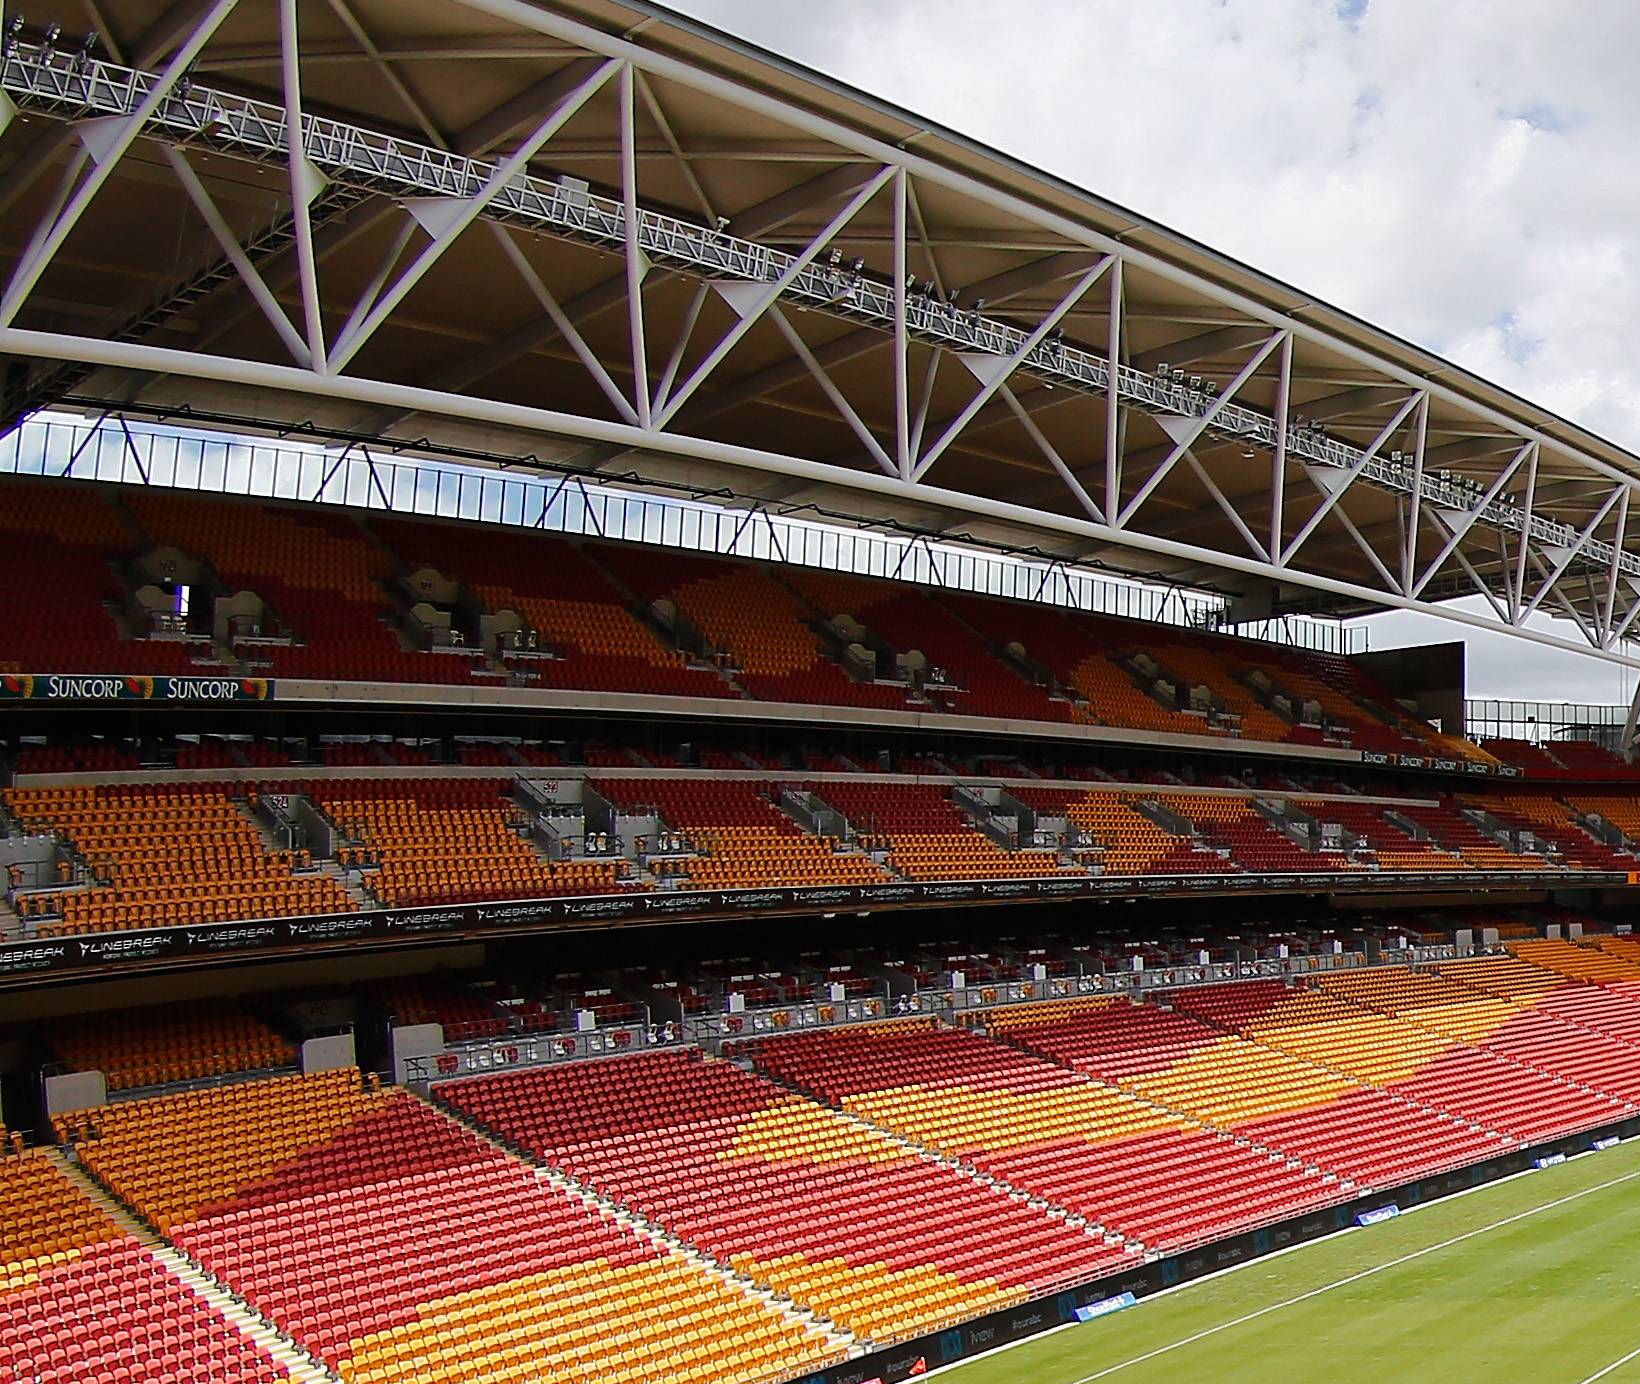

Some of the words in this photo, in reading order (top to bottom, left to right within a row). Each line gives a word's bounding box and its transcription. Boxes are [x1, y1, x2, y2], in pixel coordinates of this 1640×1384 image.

[48, 676, 123, 698] SUNCORP
[167, 677, 239, 699] SUNCORP
[273, 796, 288, 808] 524
[572, 901, 634, 913] LINEBREAK
[653, 896, 711, 908] LINEBREAK
[395, 912, 464, 925] LINEBREAK
[485, 906, 552, 919] LINEBREAK
[298, 919, 373, 933] LINEBREAK
[197, 927, 275, 943] LINEBREAK
[90, 936, 172, 953] LINEBREAK
